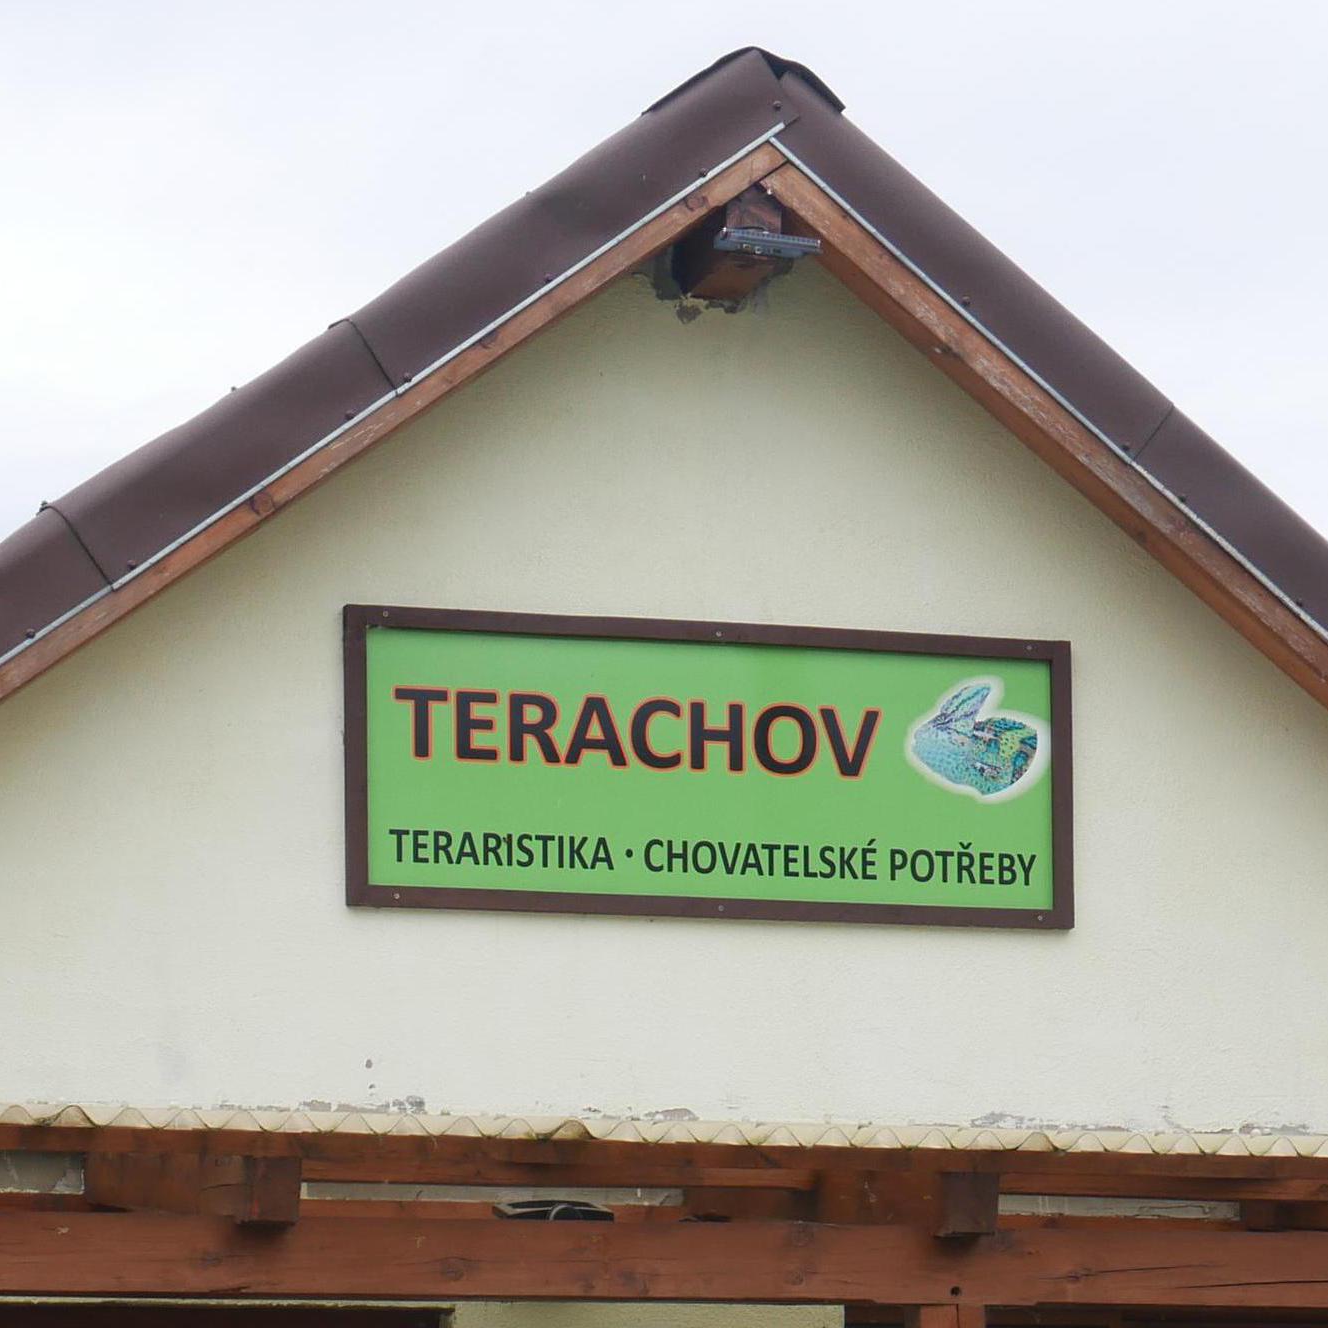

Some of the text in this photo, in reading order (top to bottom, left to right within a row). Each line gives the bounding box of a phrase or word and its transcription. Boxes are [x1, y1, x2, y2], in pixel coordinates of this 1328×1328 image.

[392, 685, 882, 781] TERACHOV
[389, 828, 614, 872] TERARISTIKA
[643, 838, 877, 882] CHOVATELSKÉ
[889, 841, 1038, 887] POTŘEBY
